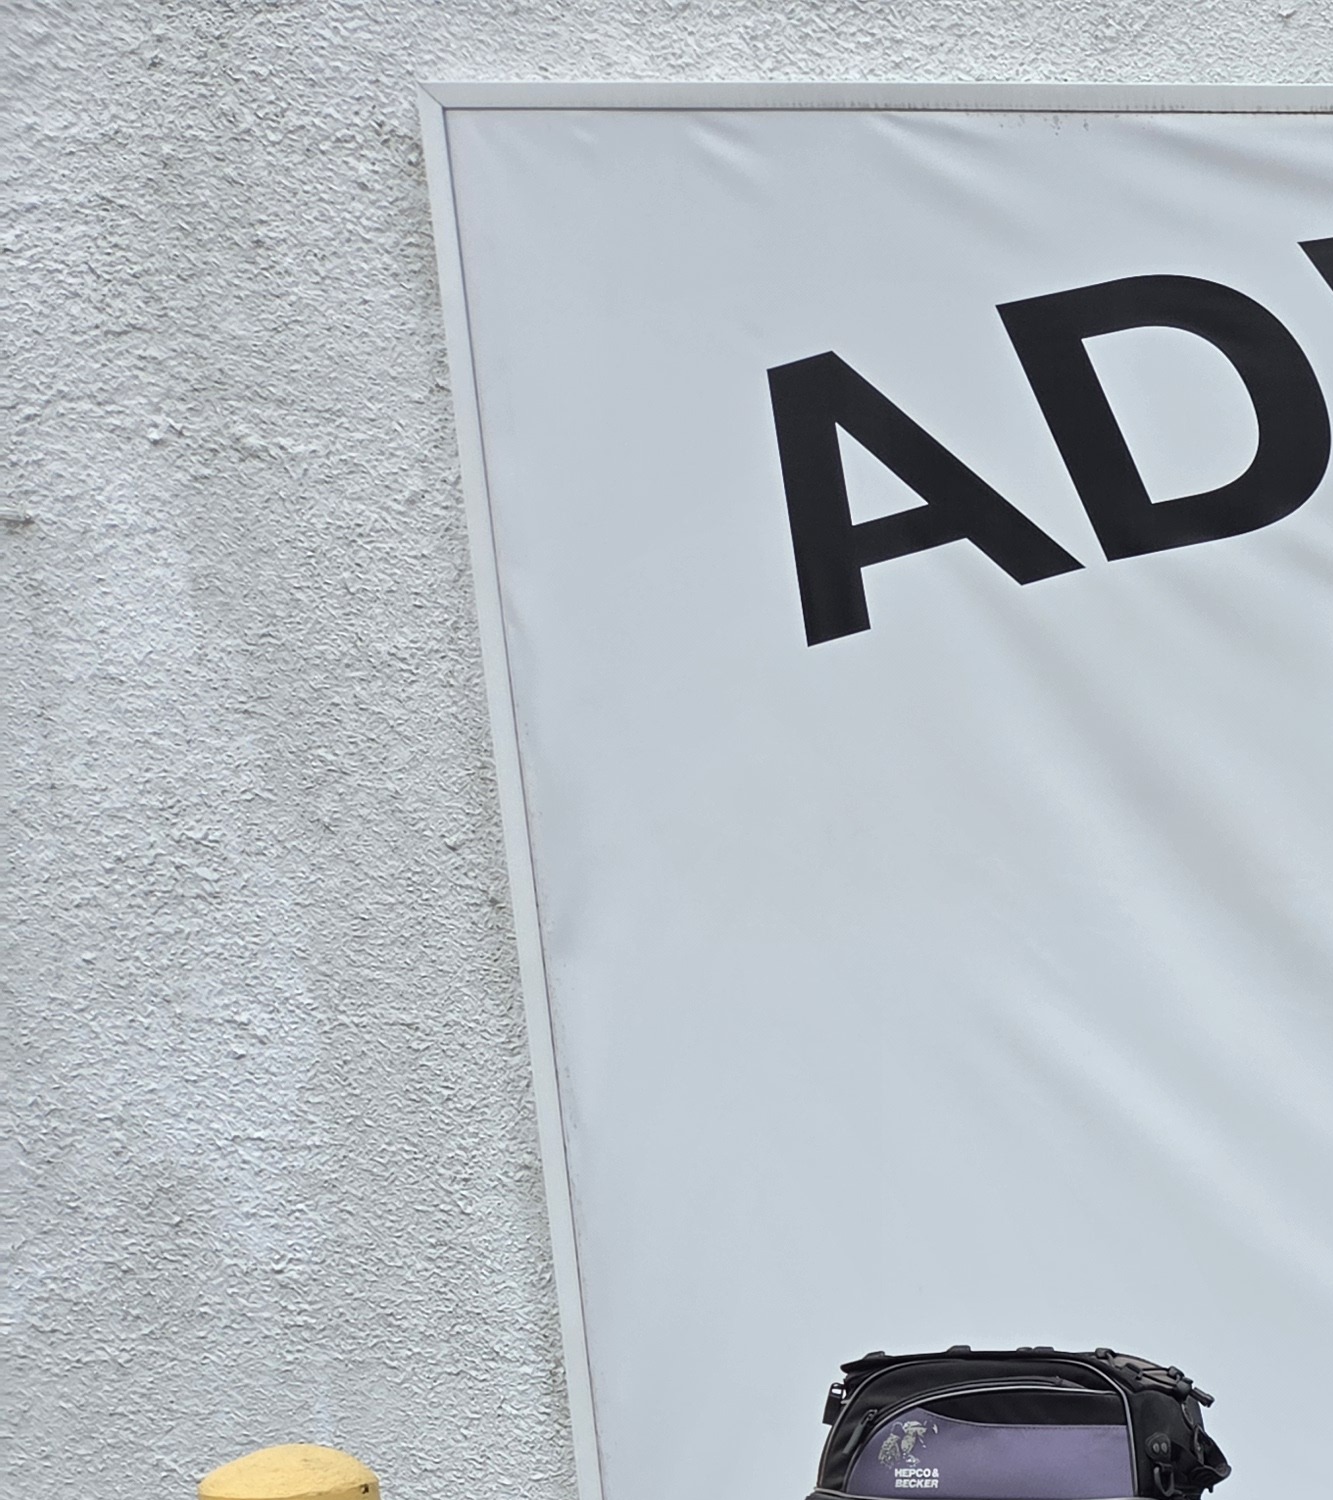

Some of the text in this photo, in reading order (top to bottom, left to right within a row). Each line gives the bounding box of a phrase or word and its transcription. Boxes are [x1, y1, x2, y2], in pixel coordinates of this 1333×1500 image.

[894, 1468, 939, 1478] HEPCO &
[894, 1479, 939, 1489] BECKER
